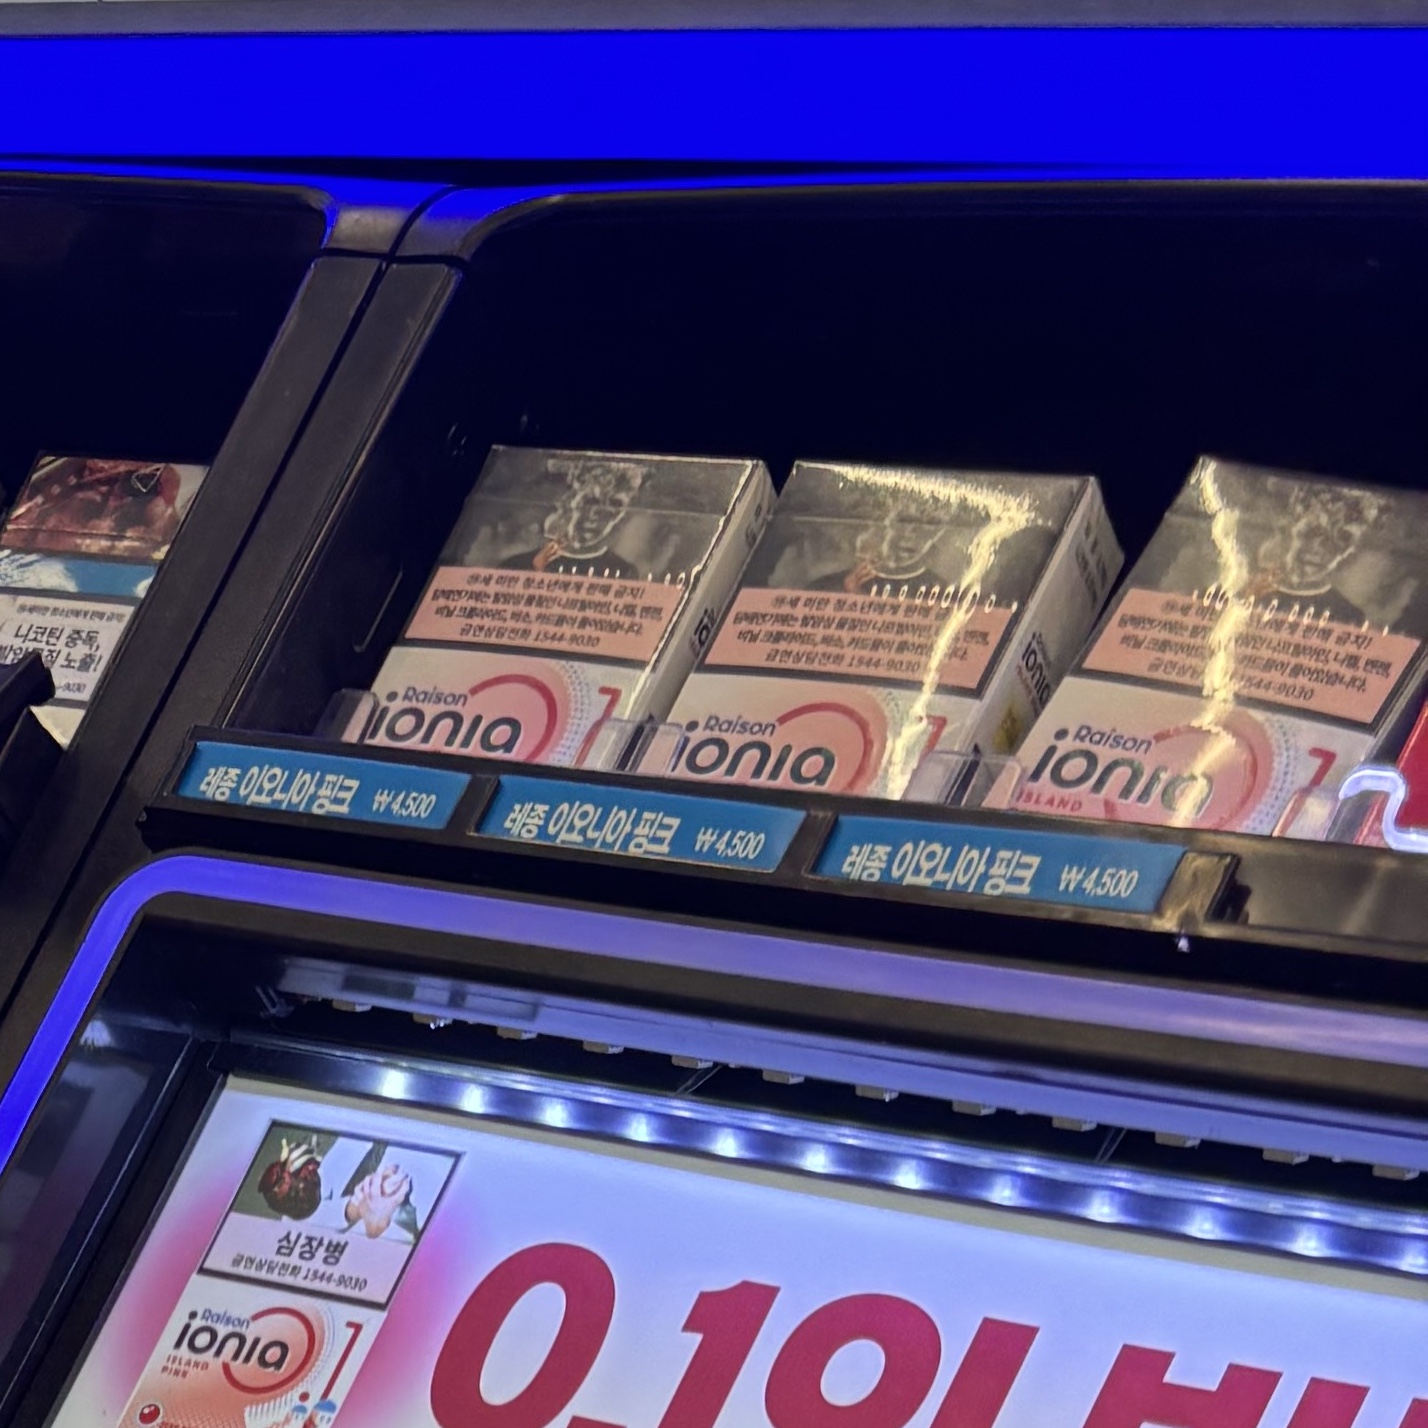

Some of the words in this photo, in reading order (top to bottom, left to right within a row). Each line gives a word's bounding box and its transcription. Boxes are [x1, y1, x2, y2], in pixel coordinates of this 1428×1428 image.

[13, 622, 58, 645] 니코틴
[401, 684, 469, 709] Raison
[367, 690, 524, 757] ionia
[198, 765, 235, 804] 레종
[238, 763, 316, 809] 이오니아
[311, 780, 361, 816] 핑크
[373, 787, 437, 819] ₩4,500
[275, 1228, 350, 1265] 심장병
[200, 1307, 252, 1330] Raison
[172, 1310, 291, 1373] ionia
